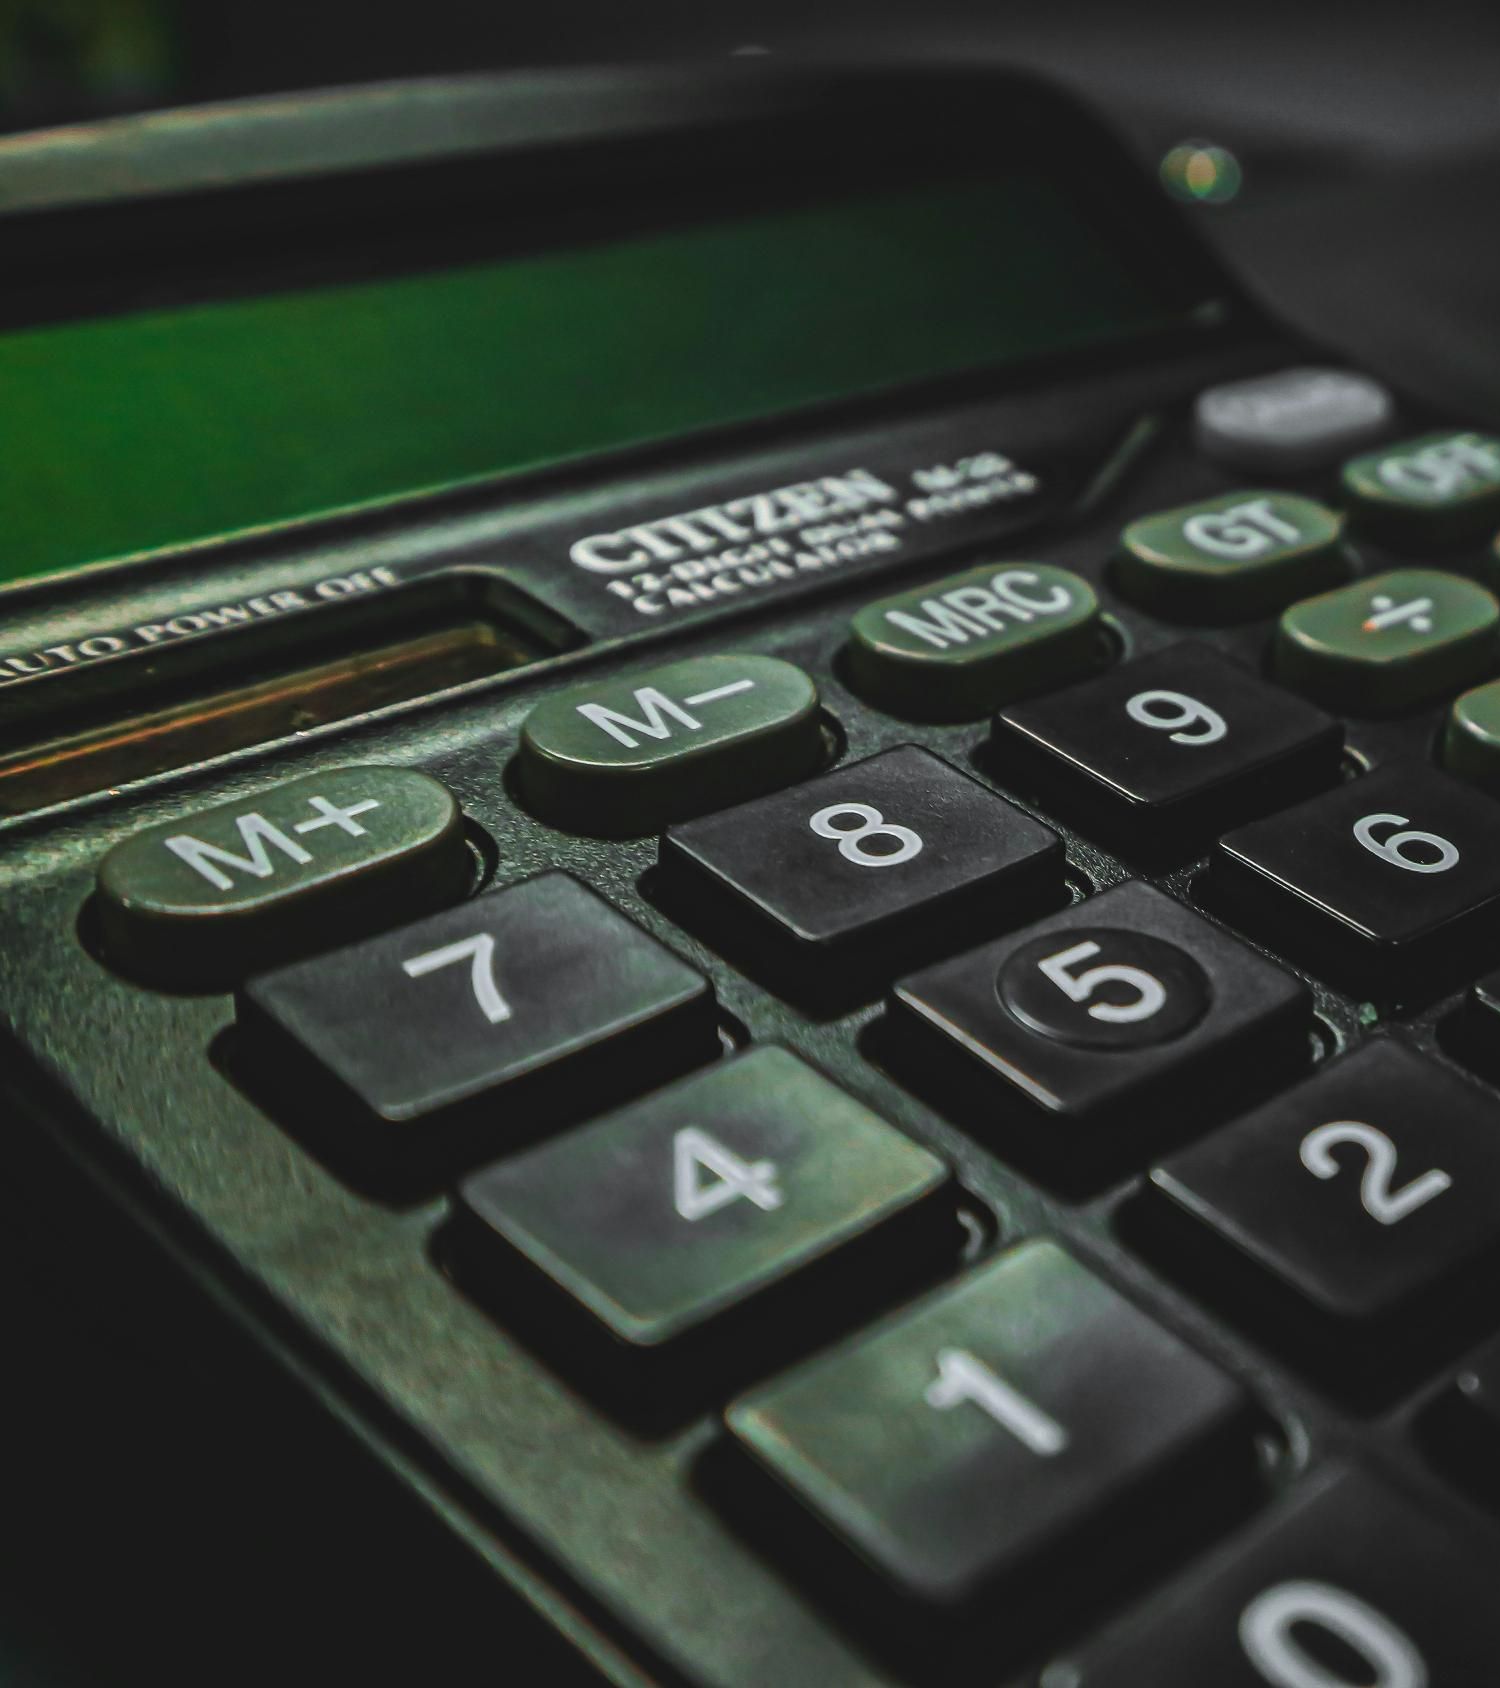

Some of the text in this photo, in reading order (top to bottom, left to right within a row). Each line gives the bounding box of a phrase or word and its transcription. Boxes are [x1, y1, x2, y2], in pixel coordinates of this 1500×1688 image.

[570, 469, 897, 573] CITIZEN
[1183, 499, 1300, 557] GT
[134, 589, 309, 643] POWER
[314, 566, 401, 600] OFF
[885, 570, 1072, 649] MRC
[1126, 689, 1228, 745] 9
[165, 796, 379, 890] M+
[809, 802, 923, 867] 8
[1353, 812, 1460, 873] 6
[402, 933, 512, 1024] 7
[1037, 940, 1167, 1023] 5
[673, 1127, 783, 1222] 4
[1300, 1120, 1452, 1225] 2
[923, 1347, 1069, 1455] 1
[1238, 1580, 1429, 1688] 0
